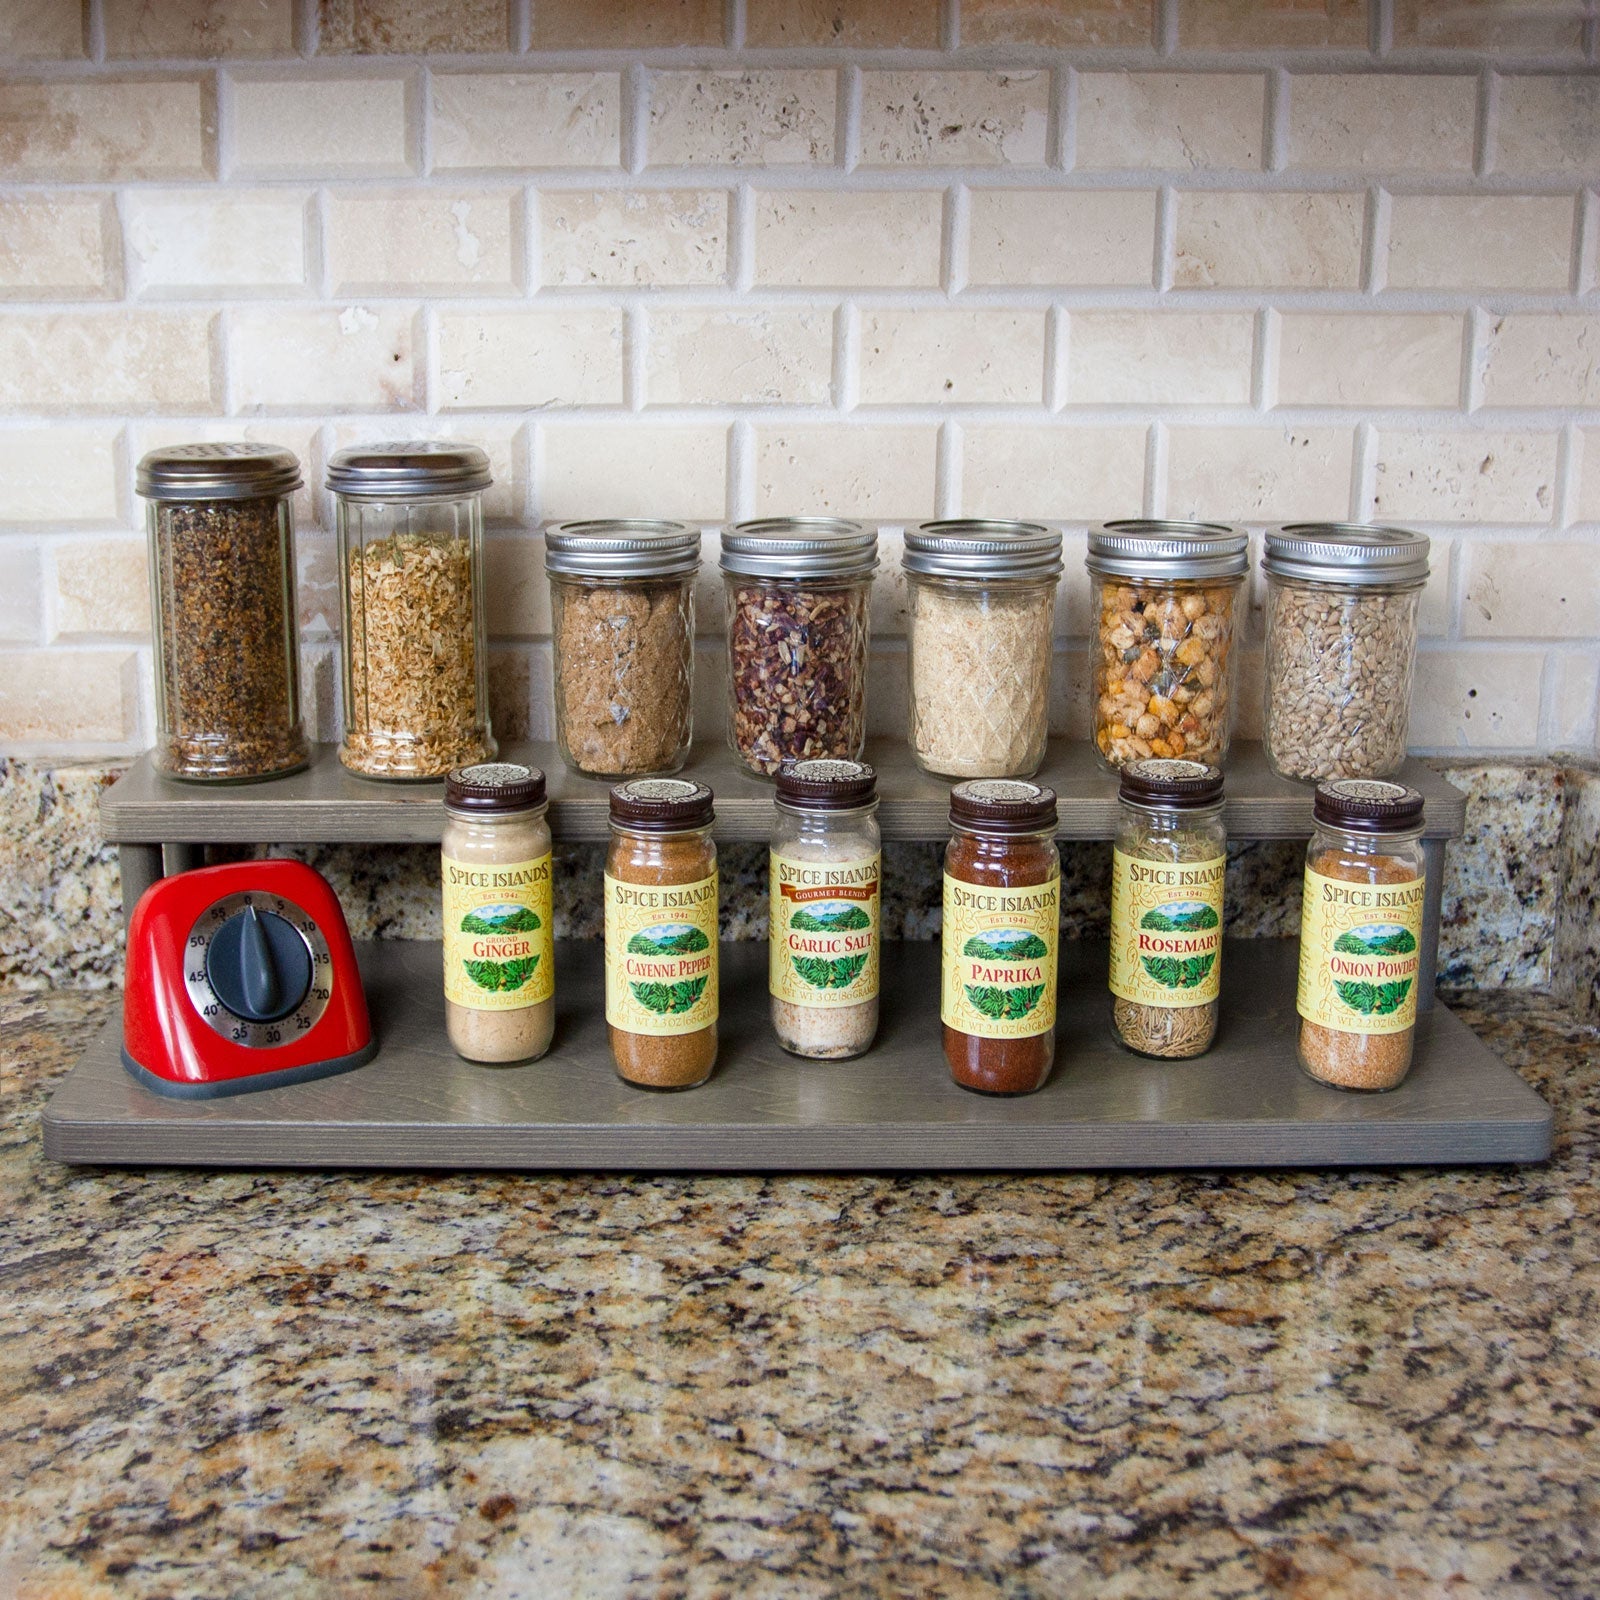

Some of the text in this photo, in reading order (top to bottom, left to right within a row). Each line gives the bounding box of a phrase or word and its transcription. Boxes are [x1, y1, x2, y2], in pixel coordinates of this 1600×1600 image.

[450, 861, 548, 887] SPICE ISLANDS
[780, 861, 878, 885] SPICE ISLANDS
[1130, 864, 1175, 884] SPICE
[616, 880, 715, 907] SPICE ISLANDS
[796, 890, 835, 899] GOURMET
[954, 887, 1055, 911] SPICE ISLANDS
[1323, 882, 1424, 907] SPICE ISLANDS
[277, 901, 285, 910] 5
[211, 907, 225, 919] 55
[303, 921, 315, 931] 10
[191, 935, 205, 947] 50
[789, 933, 872, 953] GARLIC SALT
[1139, 934, 1218, 953] ROSEMARY
[473, 941, 531, 957] GINGER
[317, 955, 329, 964] 15
[627, 955, 710, 977] CAYENNE PEPPER
[972, 964, 1041, 982] PAPRIKA
[1331, 957, 1373, 977] ONION
[190, 971, 204, 982] 45
[315, 989, 329, 999] 20
[203, 1004, 218, 1016] 40
[297, 1017, 310, 1029] 25
[232, 1027, 248, 1039] 35
[266, 1031, 281, 1043] 30
